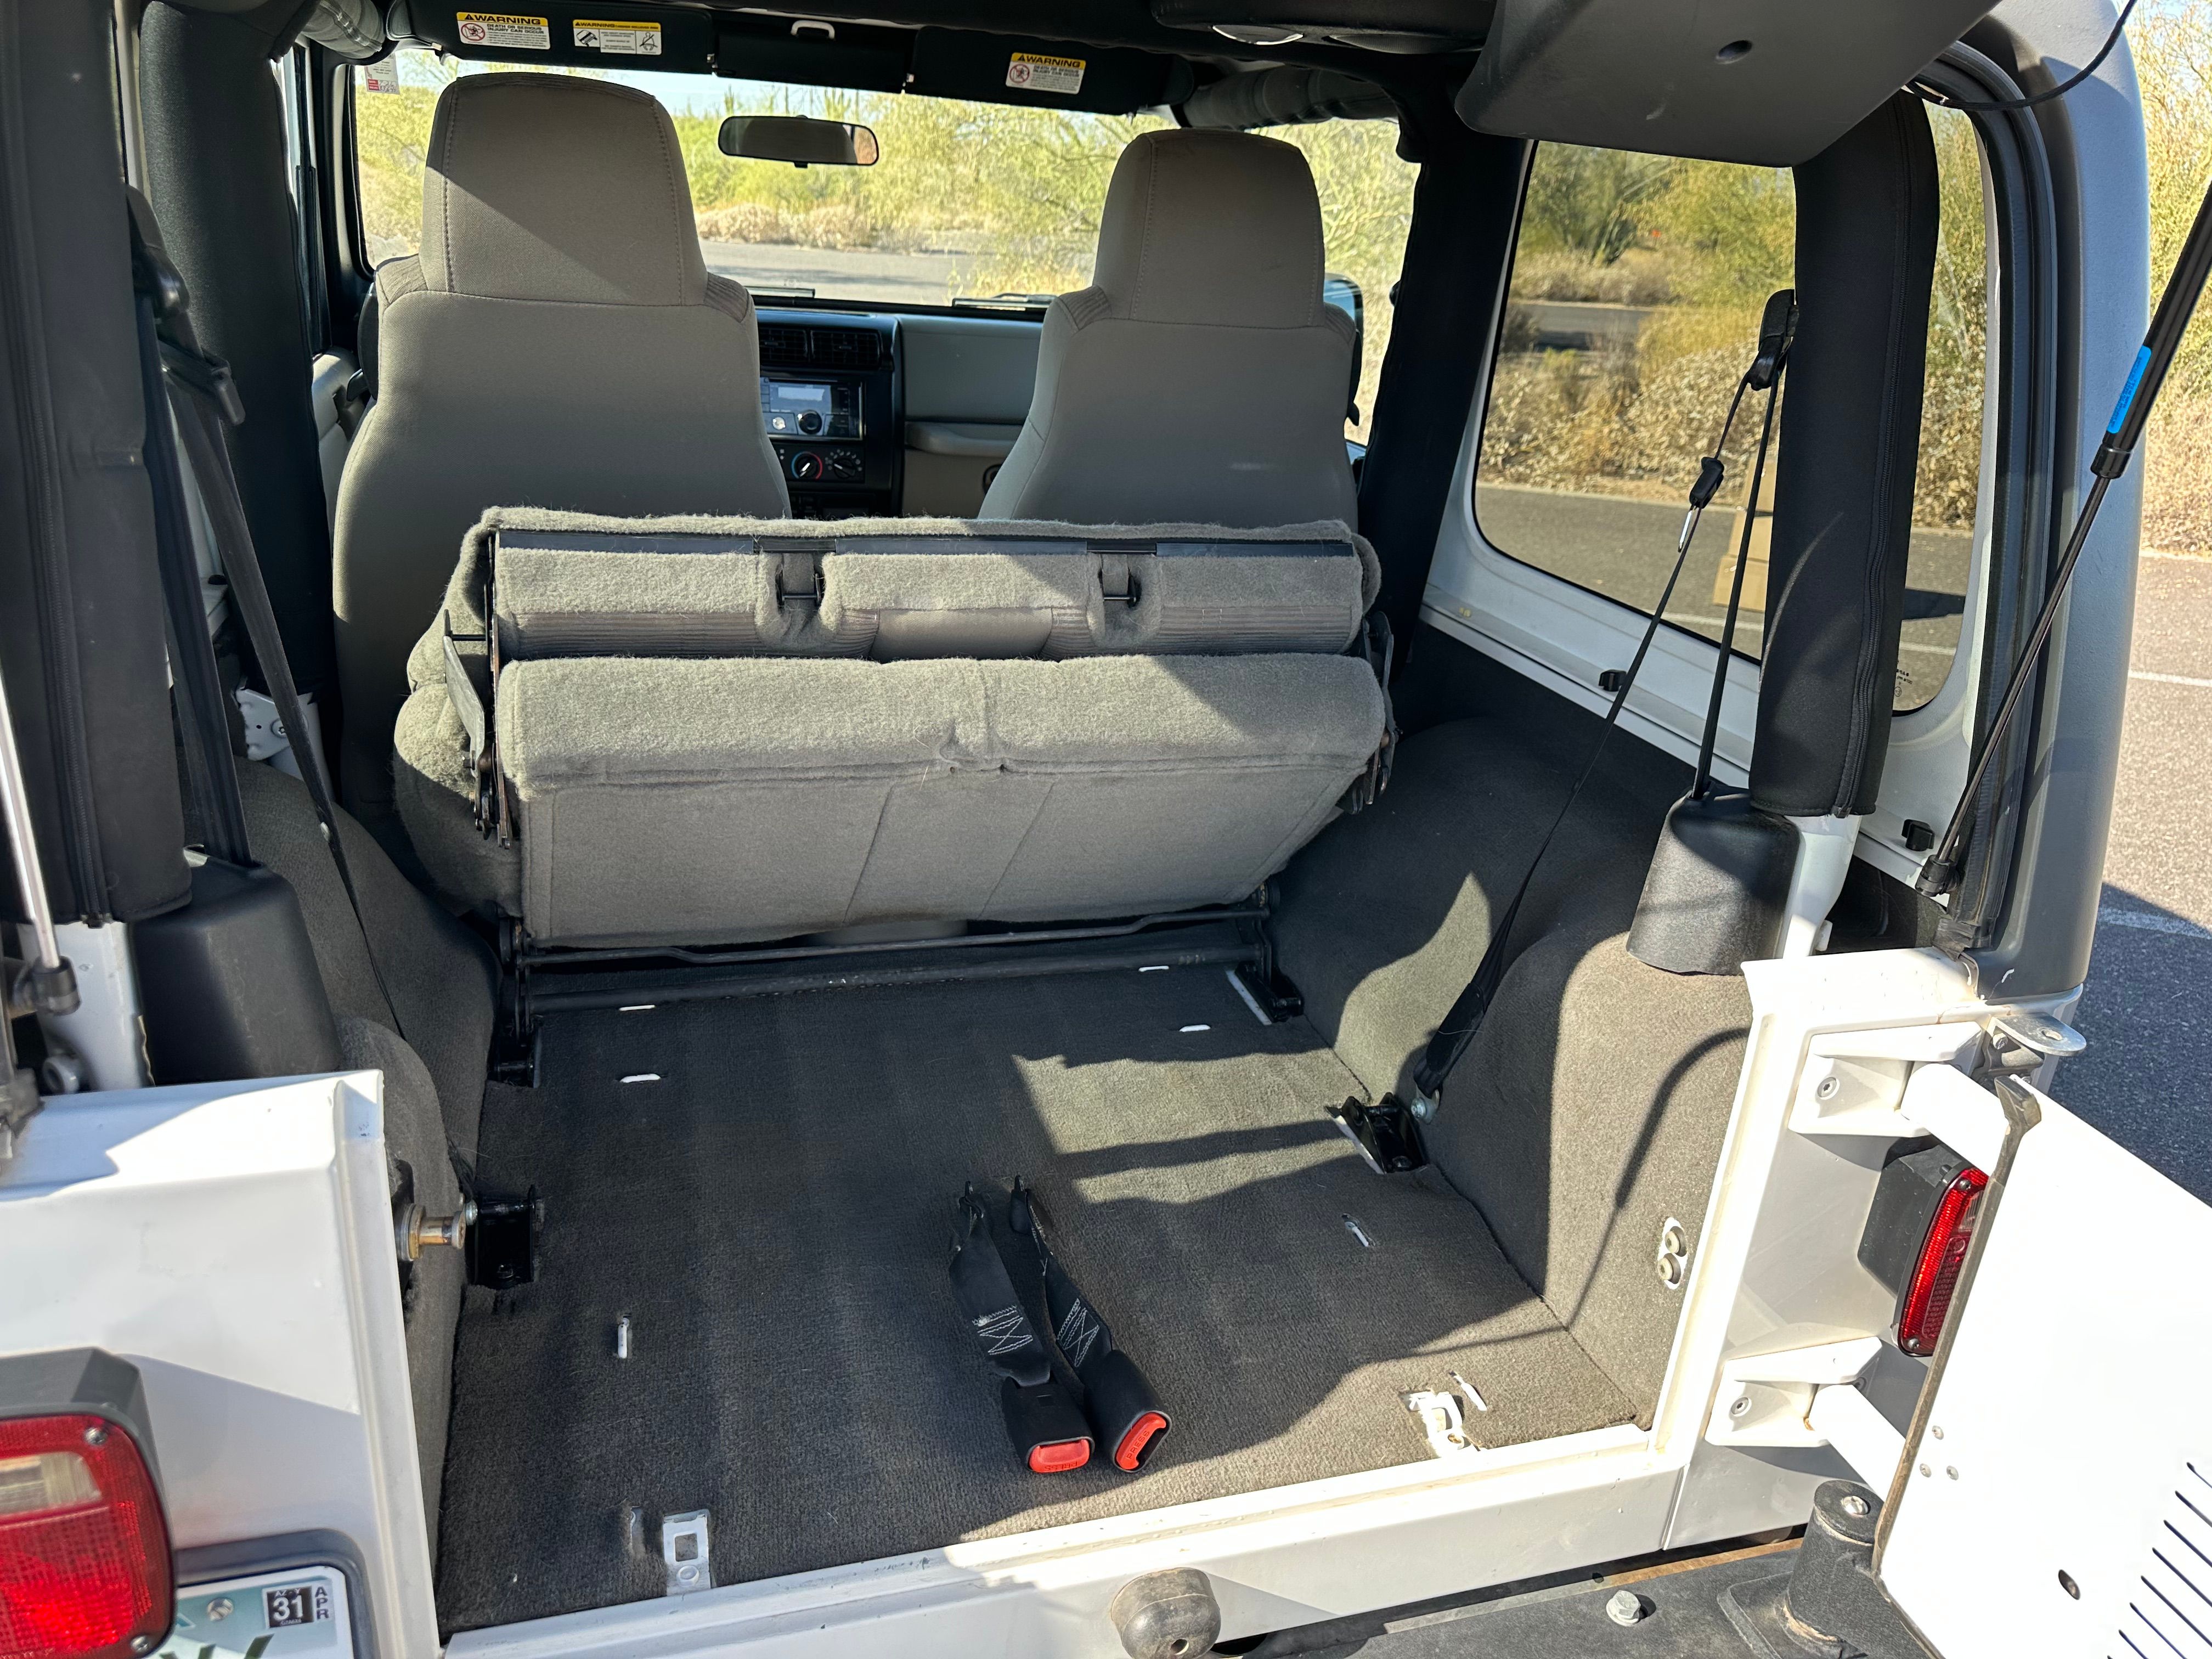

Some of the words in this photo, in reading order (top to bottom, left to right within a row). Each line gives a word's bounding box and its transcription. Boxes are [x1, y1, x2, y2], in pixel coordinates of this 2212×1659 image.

[474, 14, 541, 25] WARNING
[1026, 55, 1080, 67] WARNING
[1127, 1430, 1150, 1459] PRESS
[1045, 1461, 1077, 1471] PRESS
[273, 1595, 303, 1621] 31
[315, 1586, 329, 1620] APR
